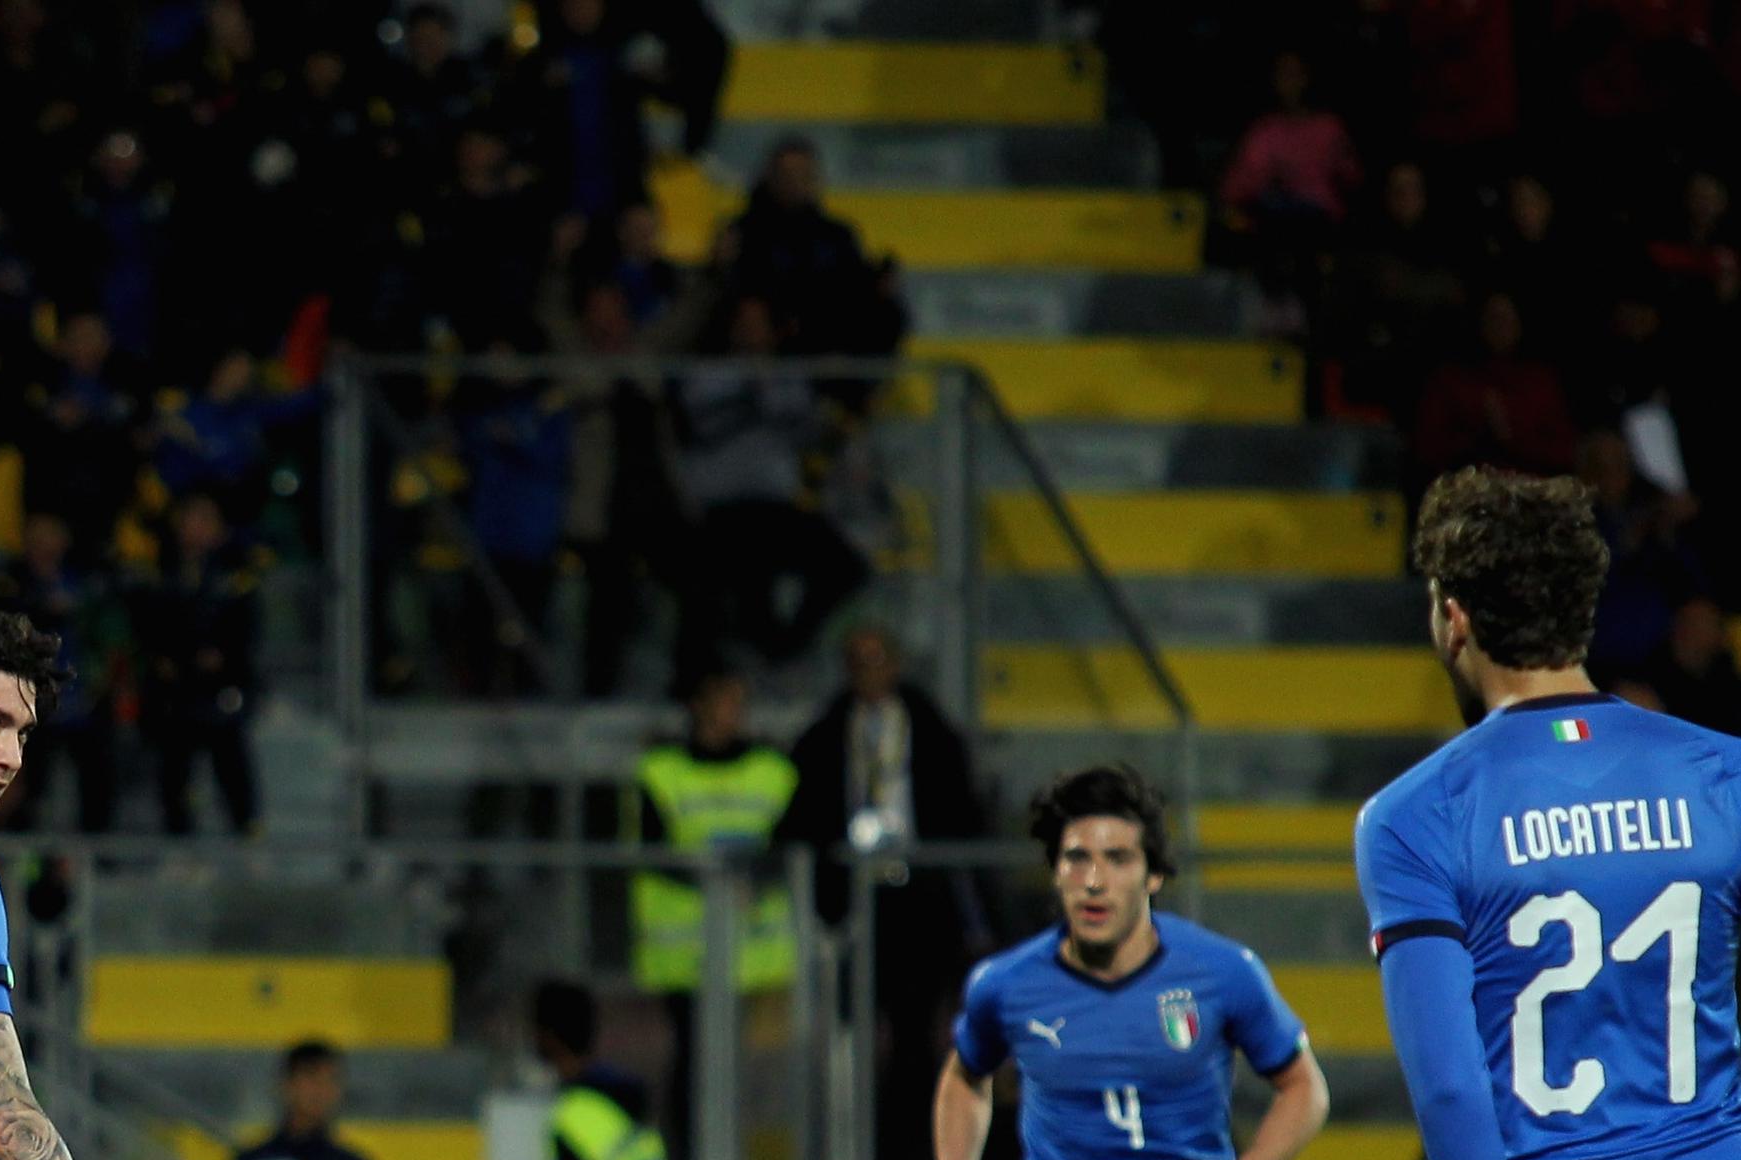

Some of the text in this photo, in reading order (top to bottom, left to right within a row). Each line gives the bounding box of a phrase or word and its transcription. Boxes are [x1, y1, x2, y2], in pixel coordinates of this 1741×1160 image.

[1502, 798, 1693, 867] LOCATELLI
[1507, 880, 1703, 1118] 21
[1102, 1083, 1146, 1150] 4
